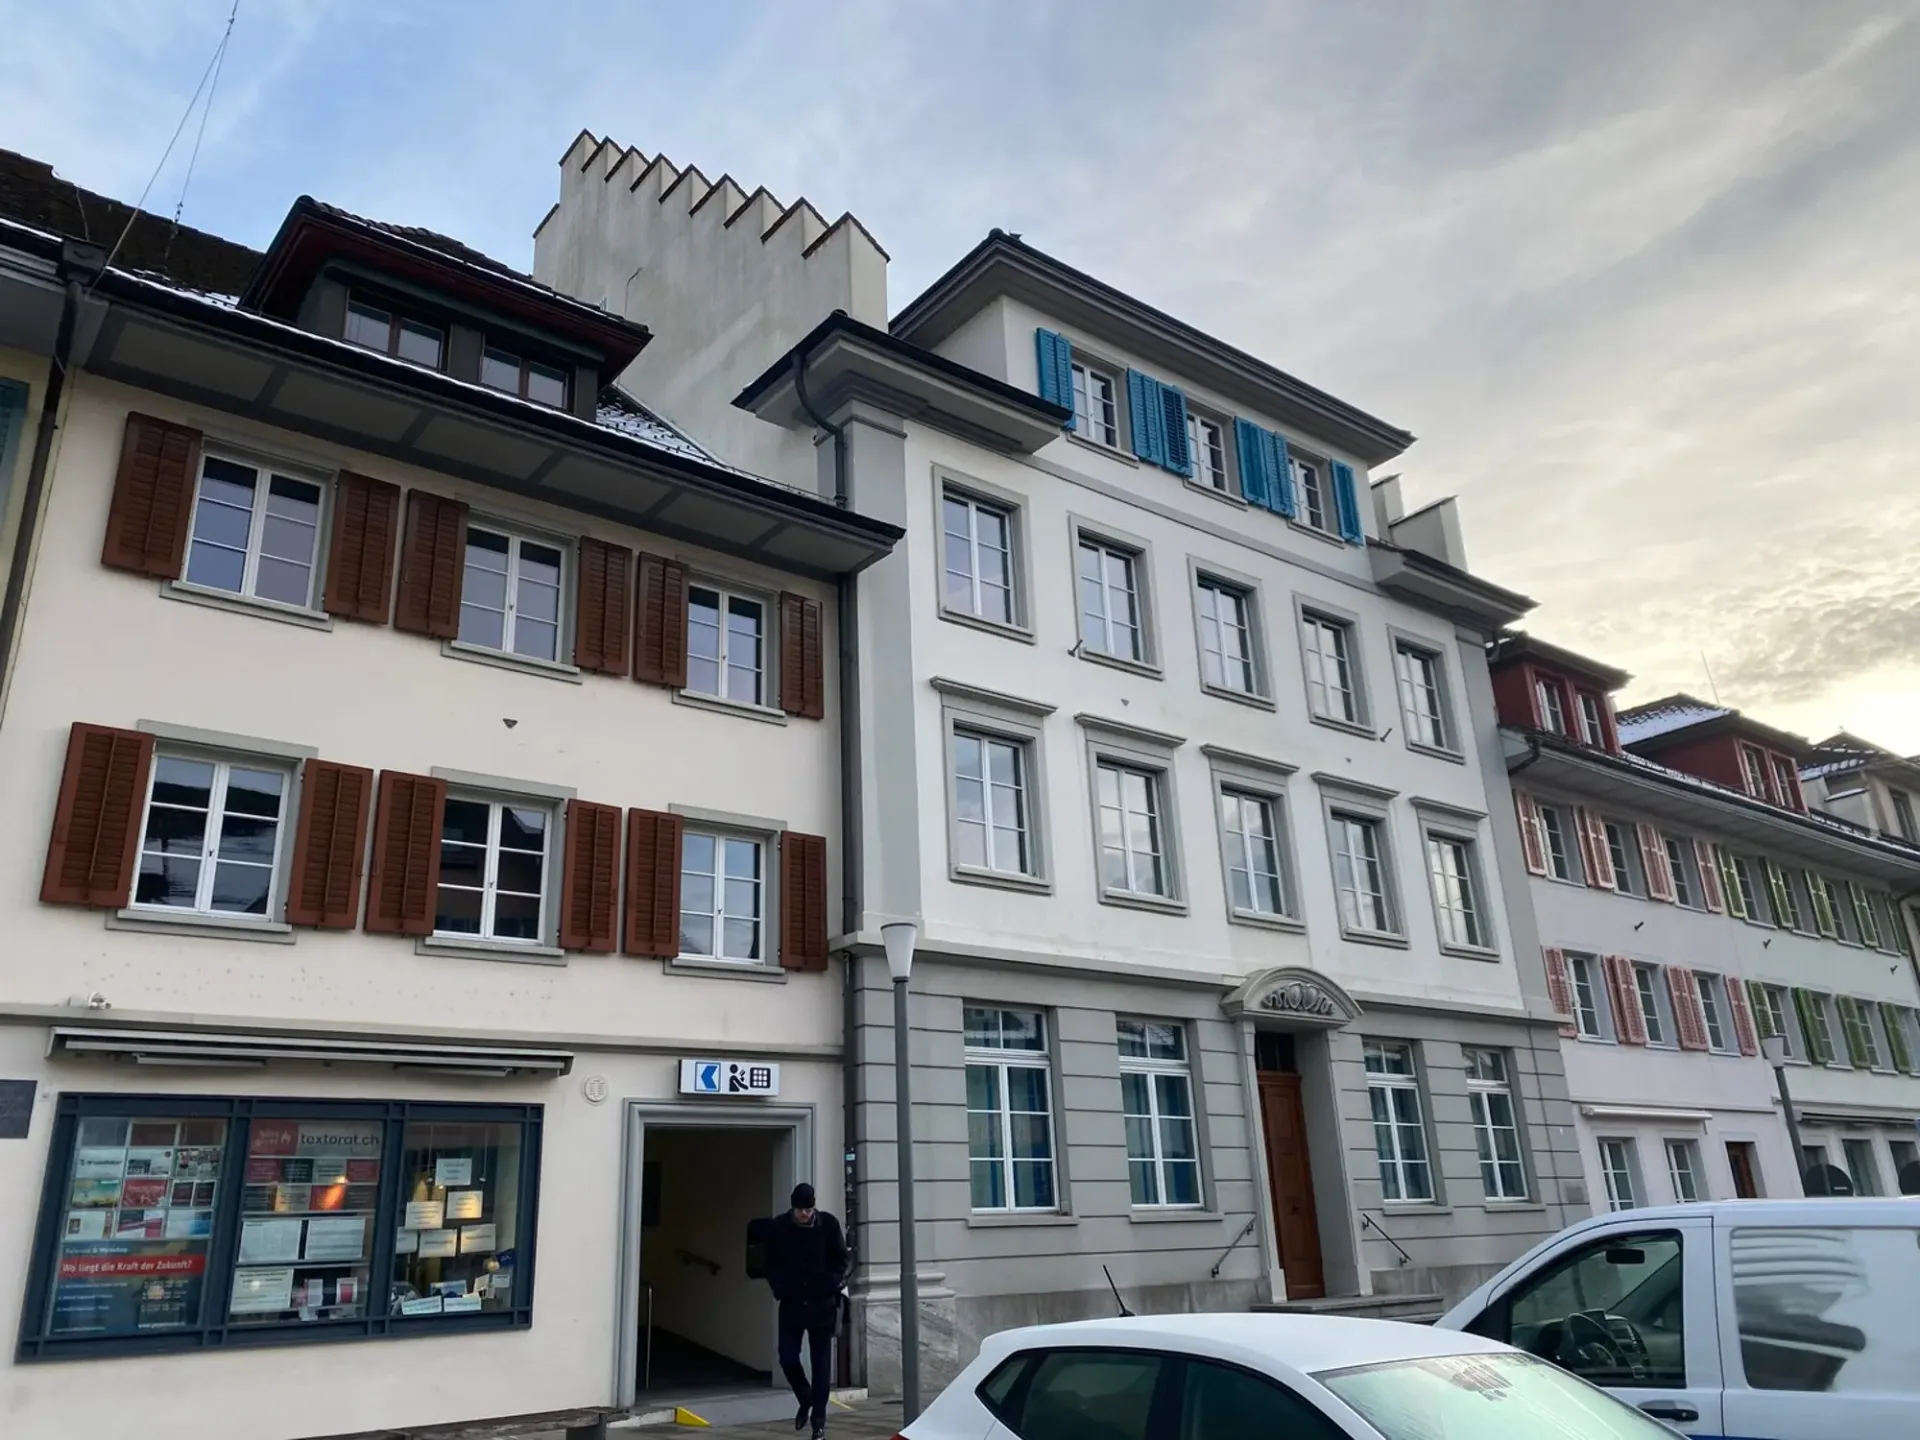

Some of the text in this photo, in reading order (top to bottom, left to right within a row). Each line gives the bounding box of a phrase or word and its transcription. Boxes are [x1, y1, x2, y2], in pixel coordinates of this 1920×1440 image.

[301, 1133, 380, 1146] textorat.ch
[62, 1260, 192, 1274] Wo liegt die Kraft der Zukunft?
